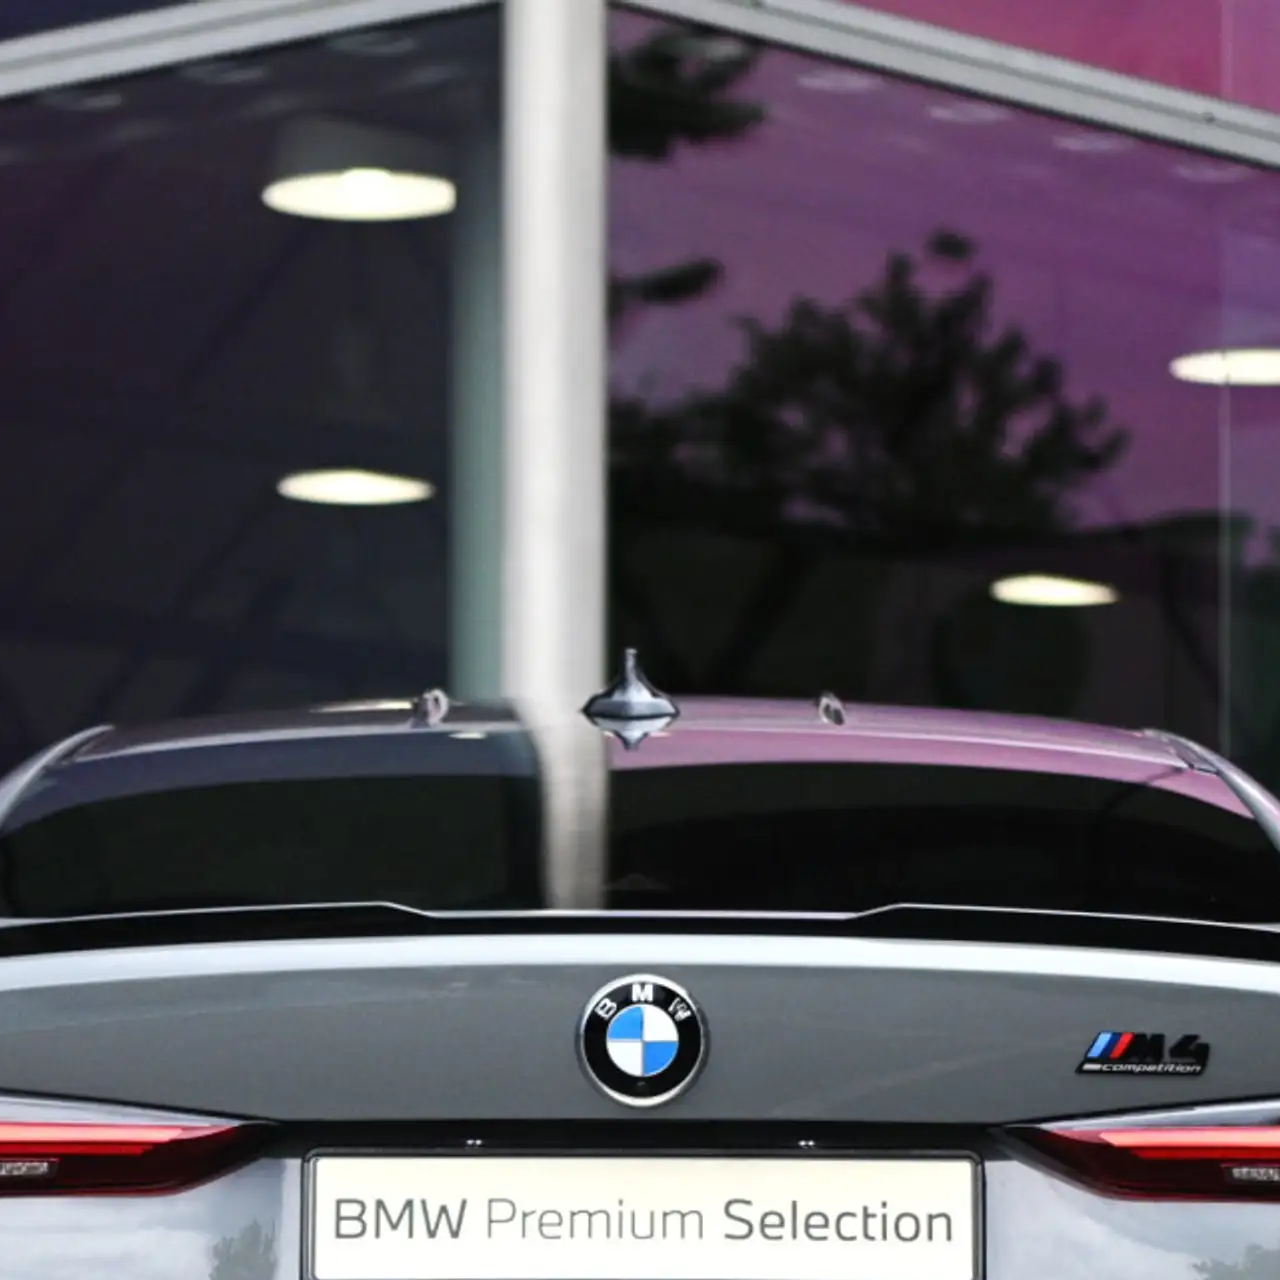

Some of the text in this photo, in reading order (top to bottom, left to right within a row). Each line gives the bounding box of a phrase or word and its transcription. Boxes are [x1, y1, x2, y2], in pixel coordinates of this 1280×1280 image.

[593, 982, 692, 1022] BMW
[1098, 1033, 1210, 1062] M4
[334, 1198, 954, 1242] BMW Premium Selection
